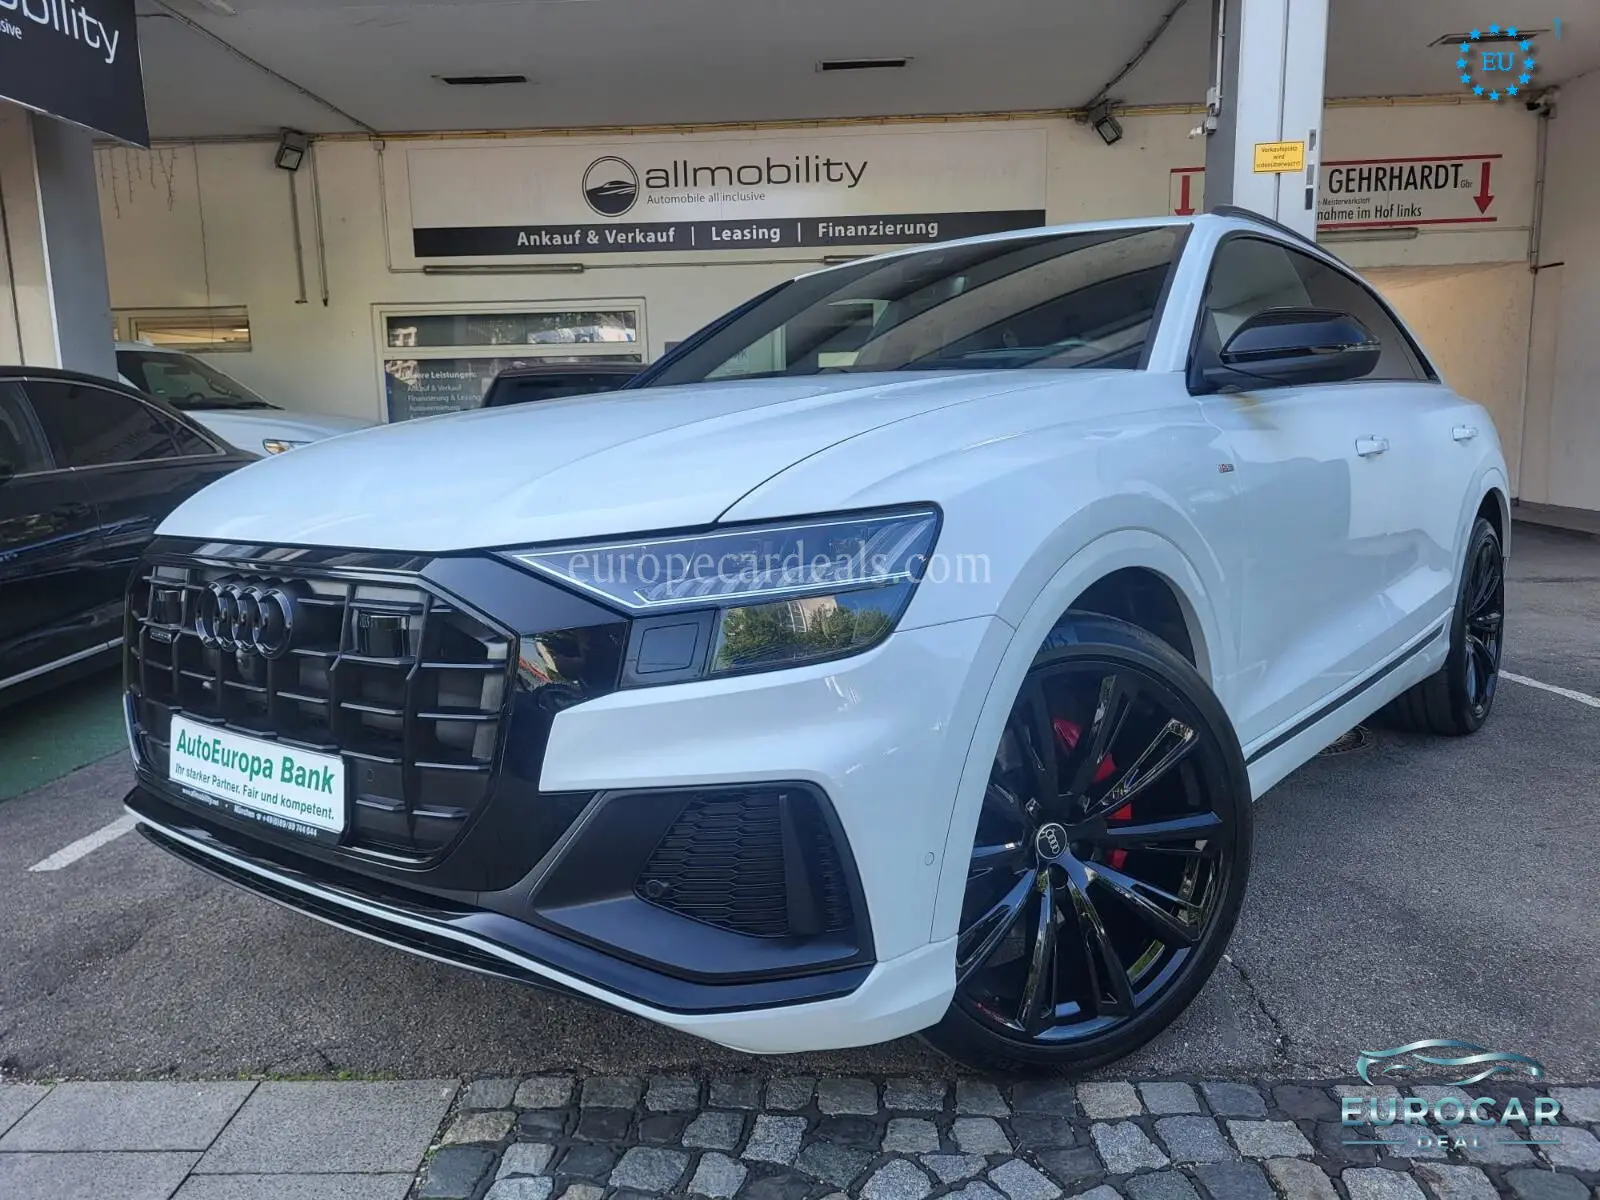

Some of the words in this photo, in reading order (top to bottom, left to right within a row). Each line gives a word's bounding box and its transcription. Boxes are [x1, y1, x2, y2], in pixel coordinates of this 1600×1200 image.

[0, 18, 22, 40] sive
[645, 155, 868, 188] allmobility
[1328, 163, 1464, 194] GEHRHARDT
[647, 193, 706, 205] Automobile
[708, 192, 720, 203] all
[722, 191, 766, 202] inclusive
[1357, 207, 1371, 220] im
[1375, 205, 1394, 218] Hof
[1397, 203, 1422, 218] links
[517, 229, 581, 247] Ankauf
[586, 230, 600, 245] &
[604, 227, 676, 244] Verkauf
[711, 226, 781, 243] Leasing
[818, 221, 939, 238] Finanzierung
[176, 729, 273, 781] AutoEuropa
[280, 756, 335, 794] Bank
[175, 763, 185, 775] Ihr
[186, 765, 210, 785] starker
[211, 771, 241, 795] Partner.
[243, 784, 258, 800] Fair
[260, 792, 278, 806] und
[280, 795, 334, 820] kompetent.
